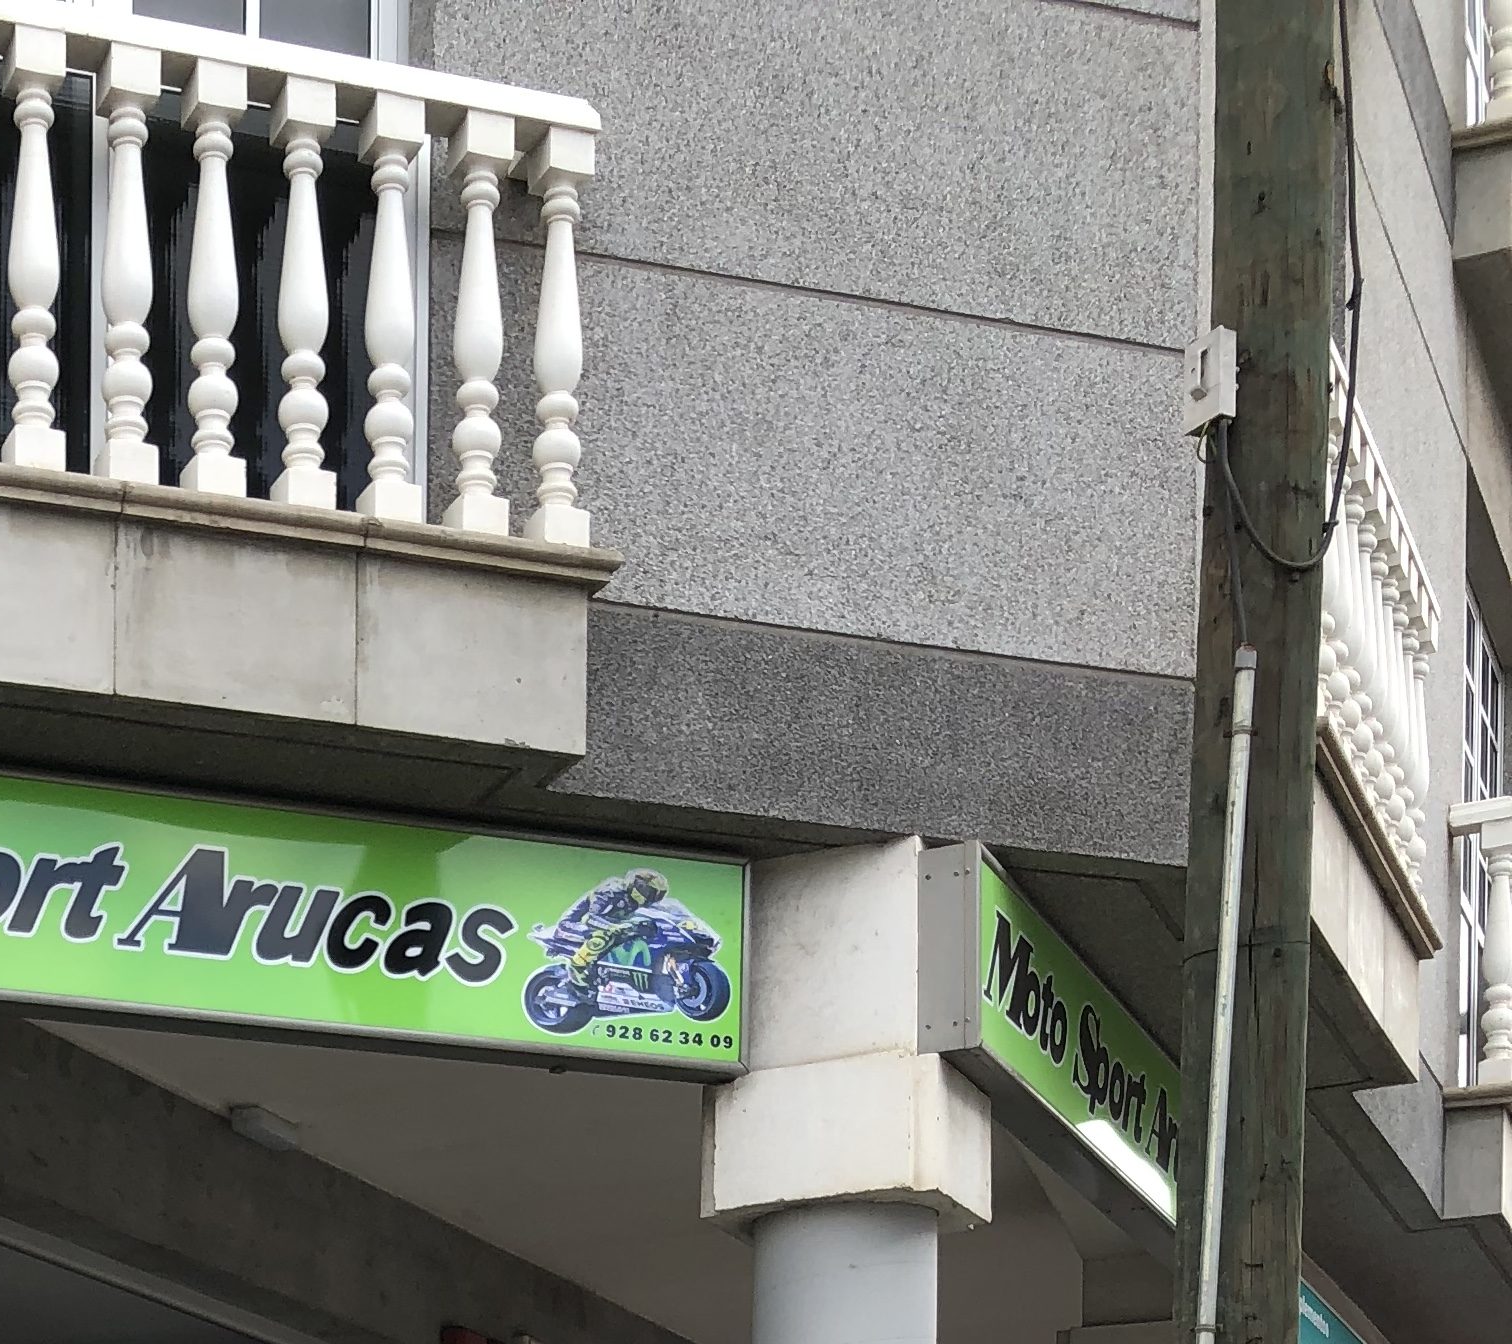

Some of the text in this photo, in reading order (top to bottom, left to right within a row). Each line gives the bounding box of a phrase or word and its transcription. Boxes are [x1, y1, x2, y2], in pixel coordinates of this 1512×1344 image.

[115, 846, 516, 985] Arucas
[606, 1024, 733, 1049] 928 62 34 09
[982, 905, 1147, 1146] Moto Sport
